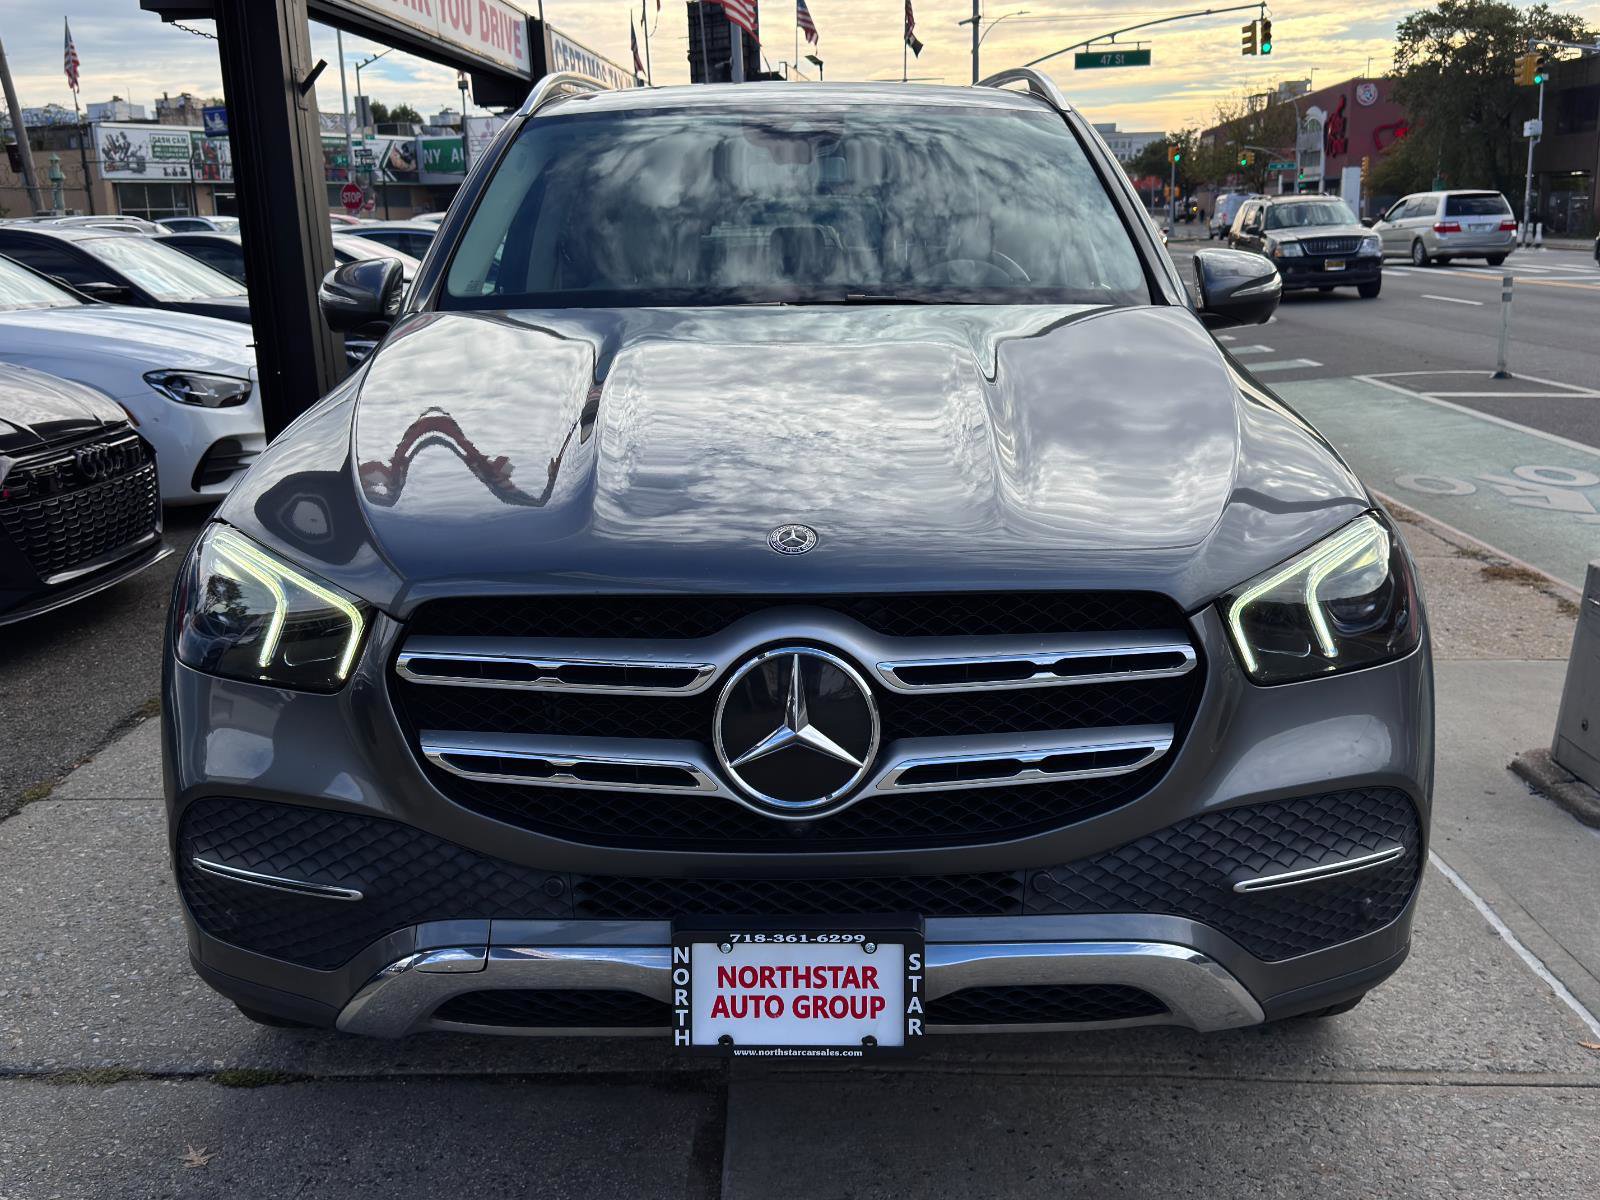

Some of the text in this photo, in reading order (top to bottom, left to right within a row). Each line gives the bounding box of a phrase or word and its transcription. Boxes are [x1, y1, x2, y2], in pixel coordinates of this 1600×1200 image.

[479, 0, 522, 59] DRIVE
[1100, 54, 1112, 65] 47
[424, 149, 440, 164] NY
[342, 191, 361, 203] STOP
[730, 934, 866, 943] 718-361-6299
[717, 965, 880, 989] NORTHSTAR
[673, 946, 690, 1046] NORTH
[907, 953, 923, 1036] STAR
[710, 994, 886, 1020] AUTO GROUP
[733, 1048, 863, 1057] www.northstarcarsales.com
